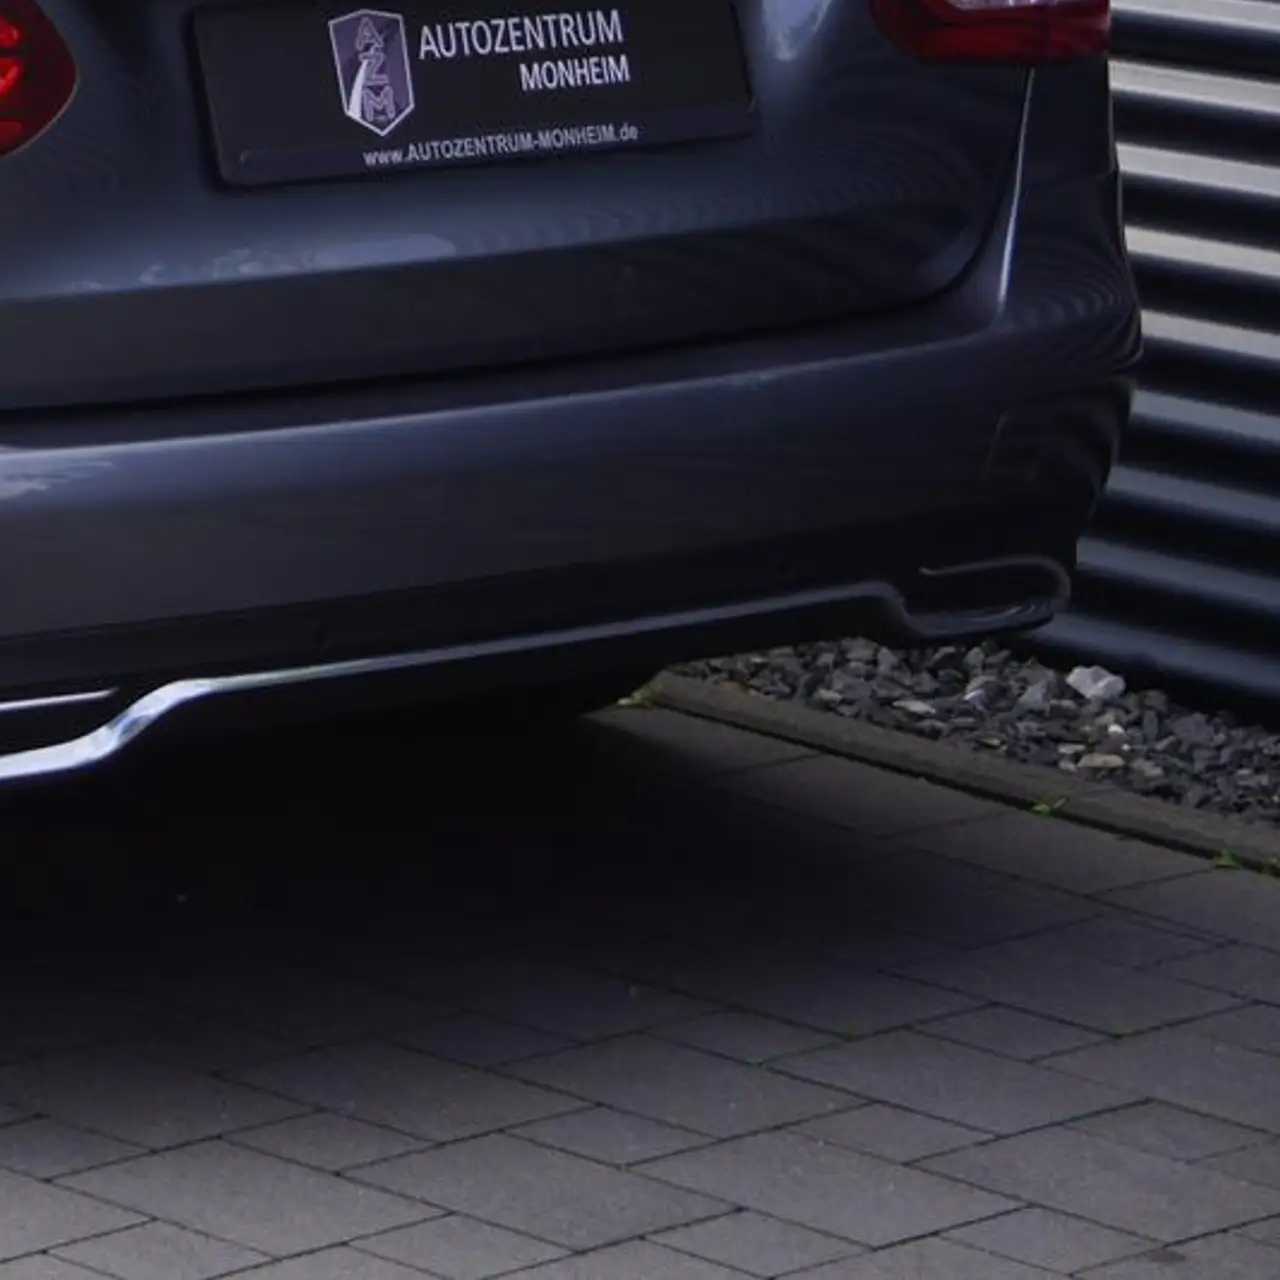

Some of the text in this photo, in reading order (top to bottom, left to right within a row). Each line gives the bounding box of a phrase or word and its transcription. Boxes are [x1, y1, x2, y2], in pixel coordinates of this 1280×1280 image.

[418, 9, 624, 60] AUTOZENTRUM
[356, 18, 395, 122] AZM
[519, 55, 631, 91] MONHEIM
[363, 123, 639, 166] www.AUTOZENTRUM-MONHEIM.de
